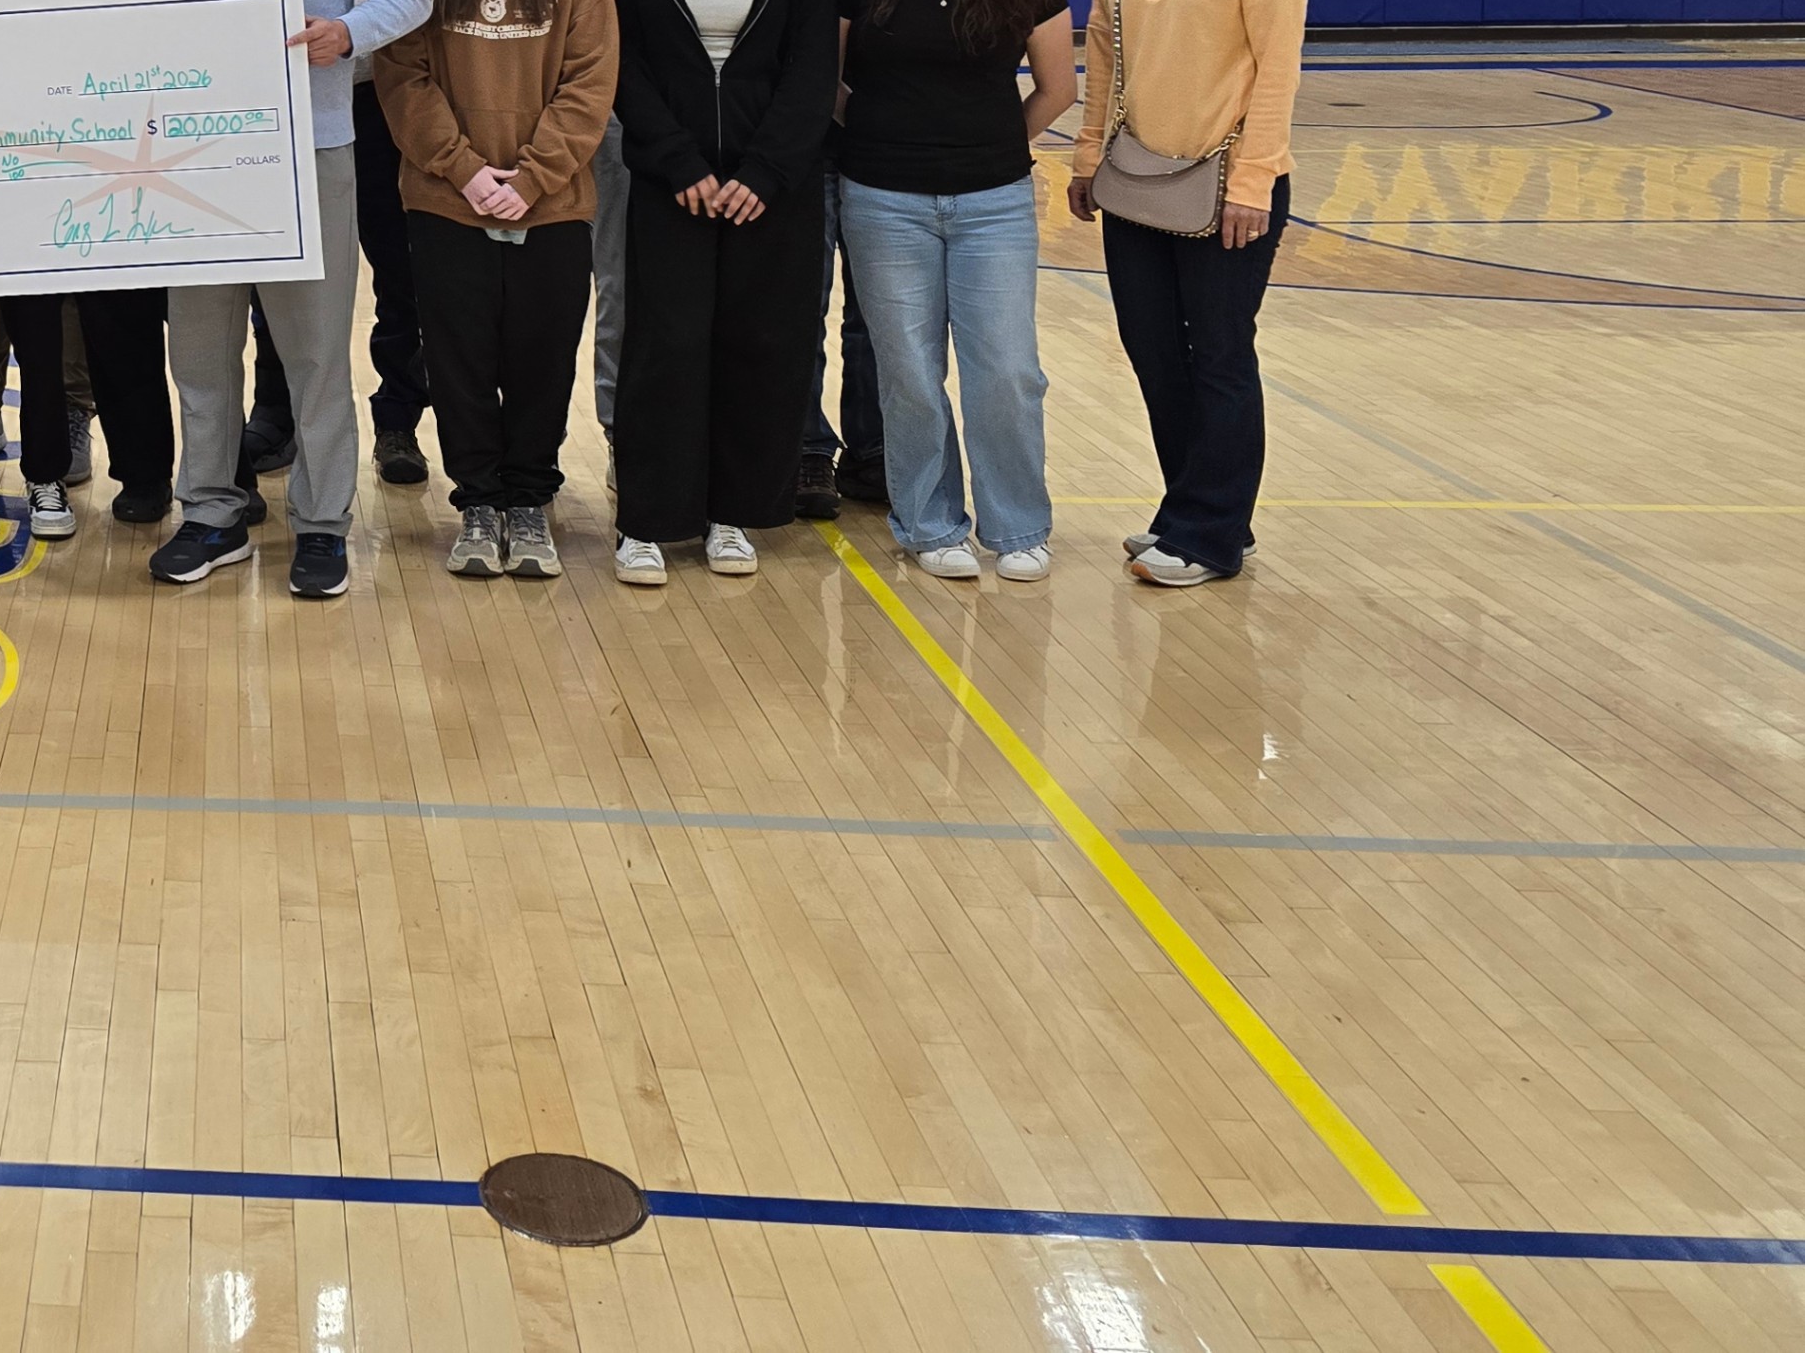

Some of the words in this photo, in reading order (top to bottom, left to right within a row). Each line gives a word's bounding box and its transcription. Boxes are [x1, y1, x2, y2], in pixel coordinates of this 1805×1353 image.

[47, 86, 72, 96] DATE
[83, 72, 129, 100] April
[162, 69, 213, 89] 2026
[71, 117, 133, 142] School
[147, 119, 158, 136] $
[235, 154, 280, 166] DOLLARS
